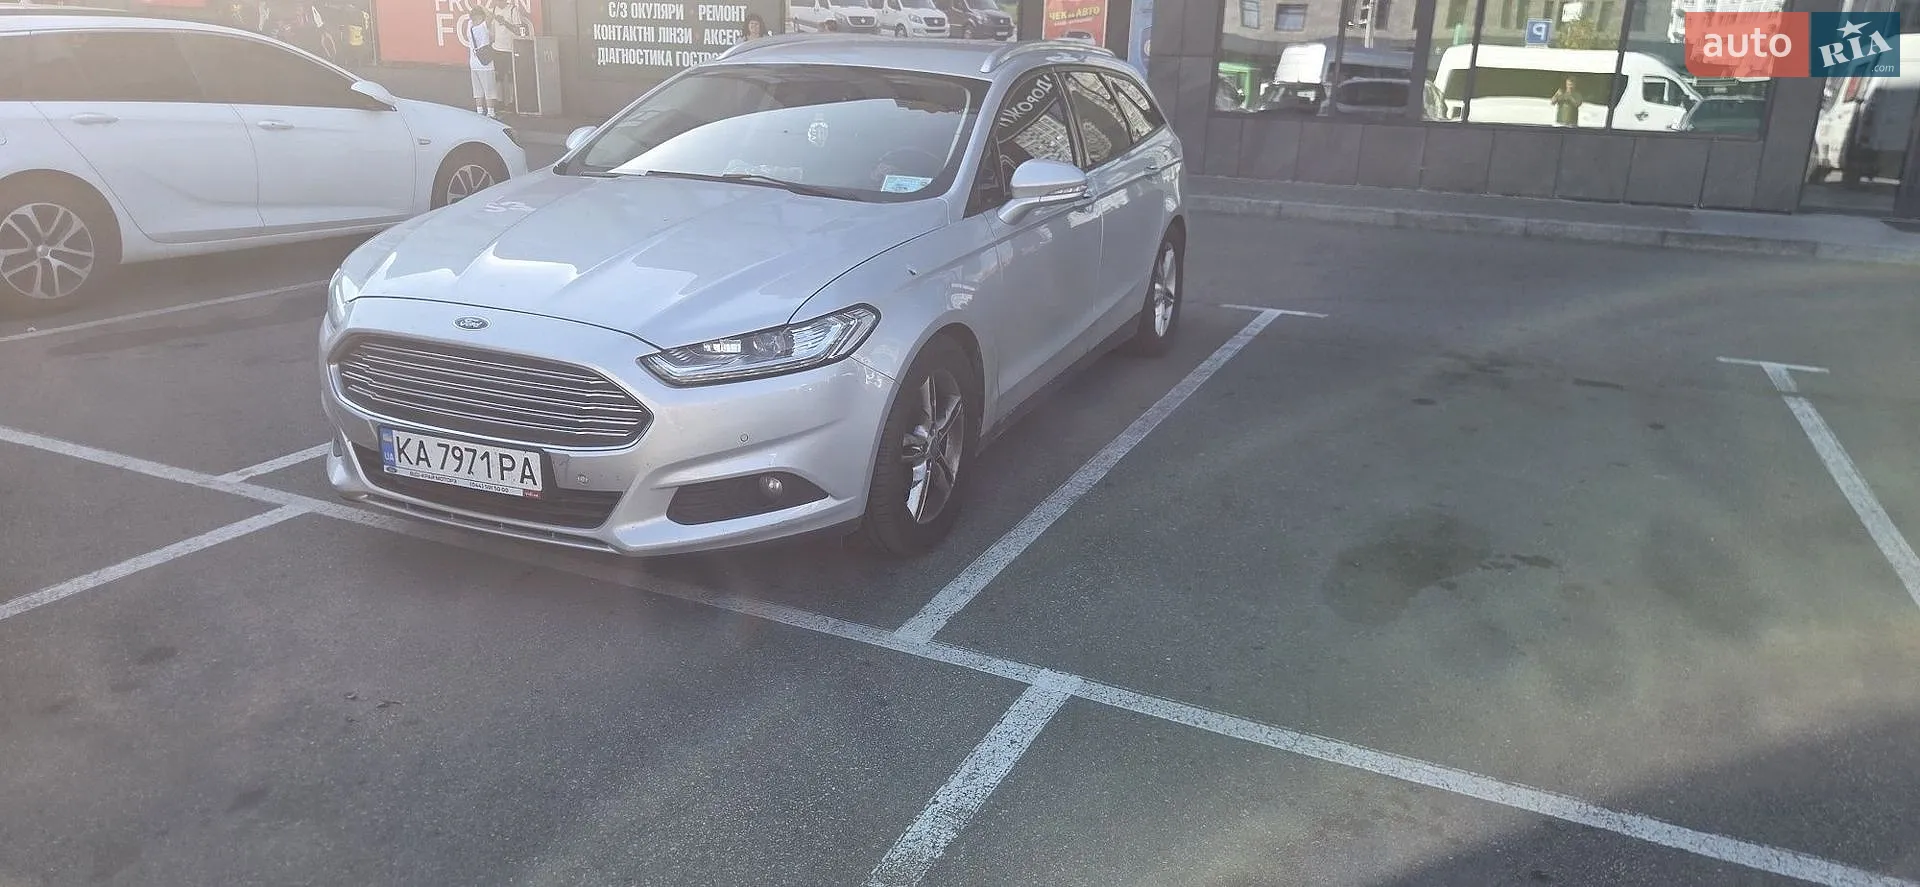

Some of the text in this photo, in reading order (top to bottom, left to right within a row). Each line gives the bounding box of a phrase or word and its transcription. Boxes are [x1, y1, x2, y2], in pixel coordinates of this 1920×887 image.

[630, 3, 684, 20] ОКУЛЯРИ
[698, 5, 747, 22] РЕМОНТ
[1075, 6, 1101, 18] АВТО
[593, 24, 743, 45] КОНТАКТНІ ЛІНЗИ АКСЕС
[597, 48, 673, 67] ДІАГНОСТИКА
[384, 452, 394, 462] UA
[396, 436, 537, 486] KA 7971 PA
